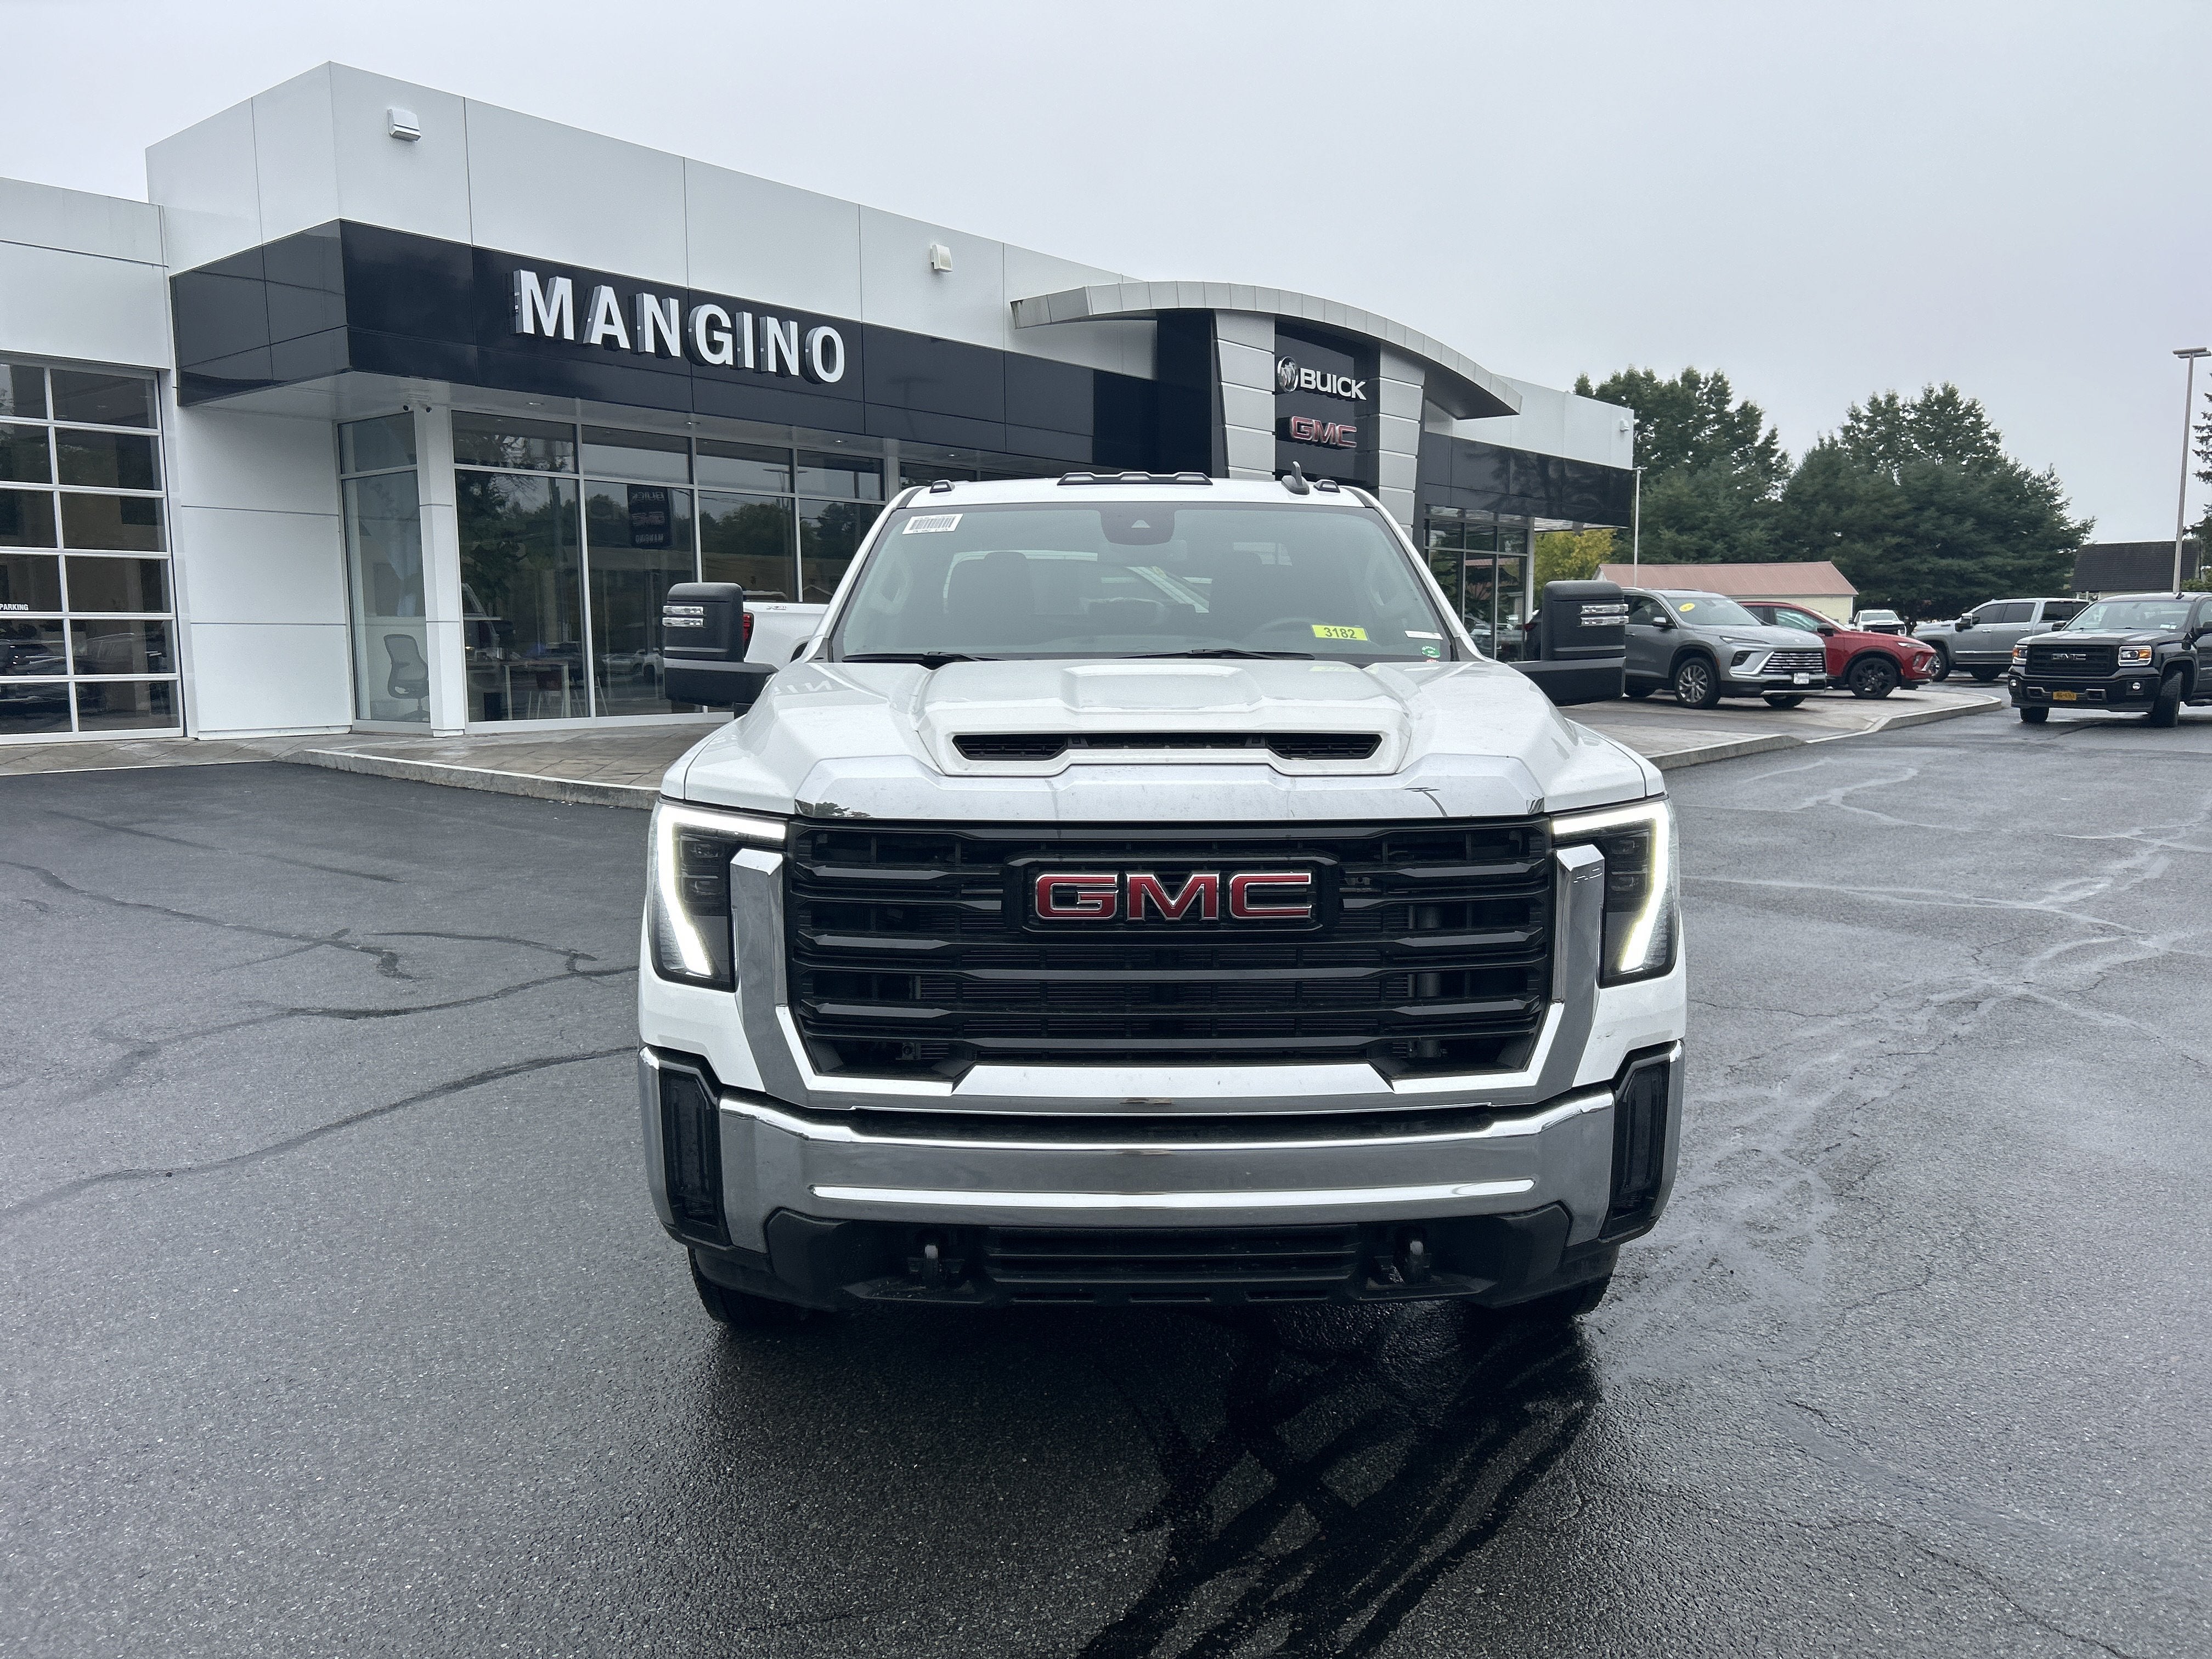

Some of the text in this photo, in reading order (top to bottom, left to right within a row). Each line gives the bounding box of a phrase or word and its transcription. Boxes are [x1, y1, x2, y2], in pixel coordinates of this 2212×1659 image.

[513, 269, 845, 383] MANGINO
[1300, 368, 1367, 400] BUICK
[1291, 416, 1357, 448] GMC
[1323, 627, 1357, 639] 3182
[1035, 872, 1312, 921] GMC
